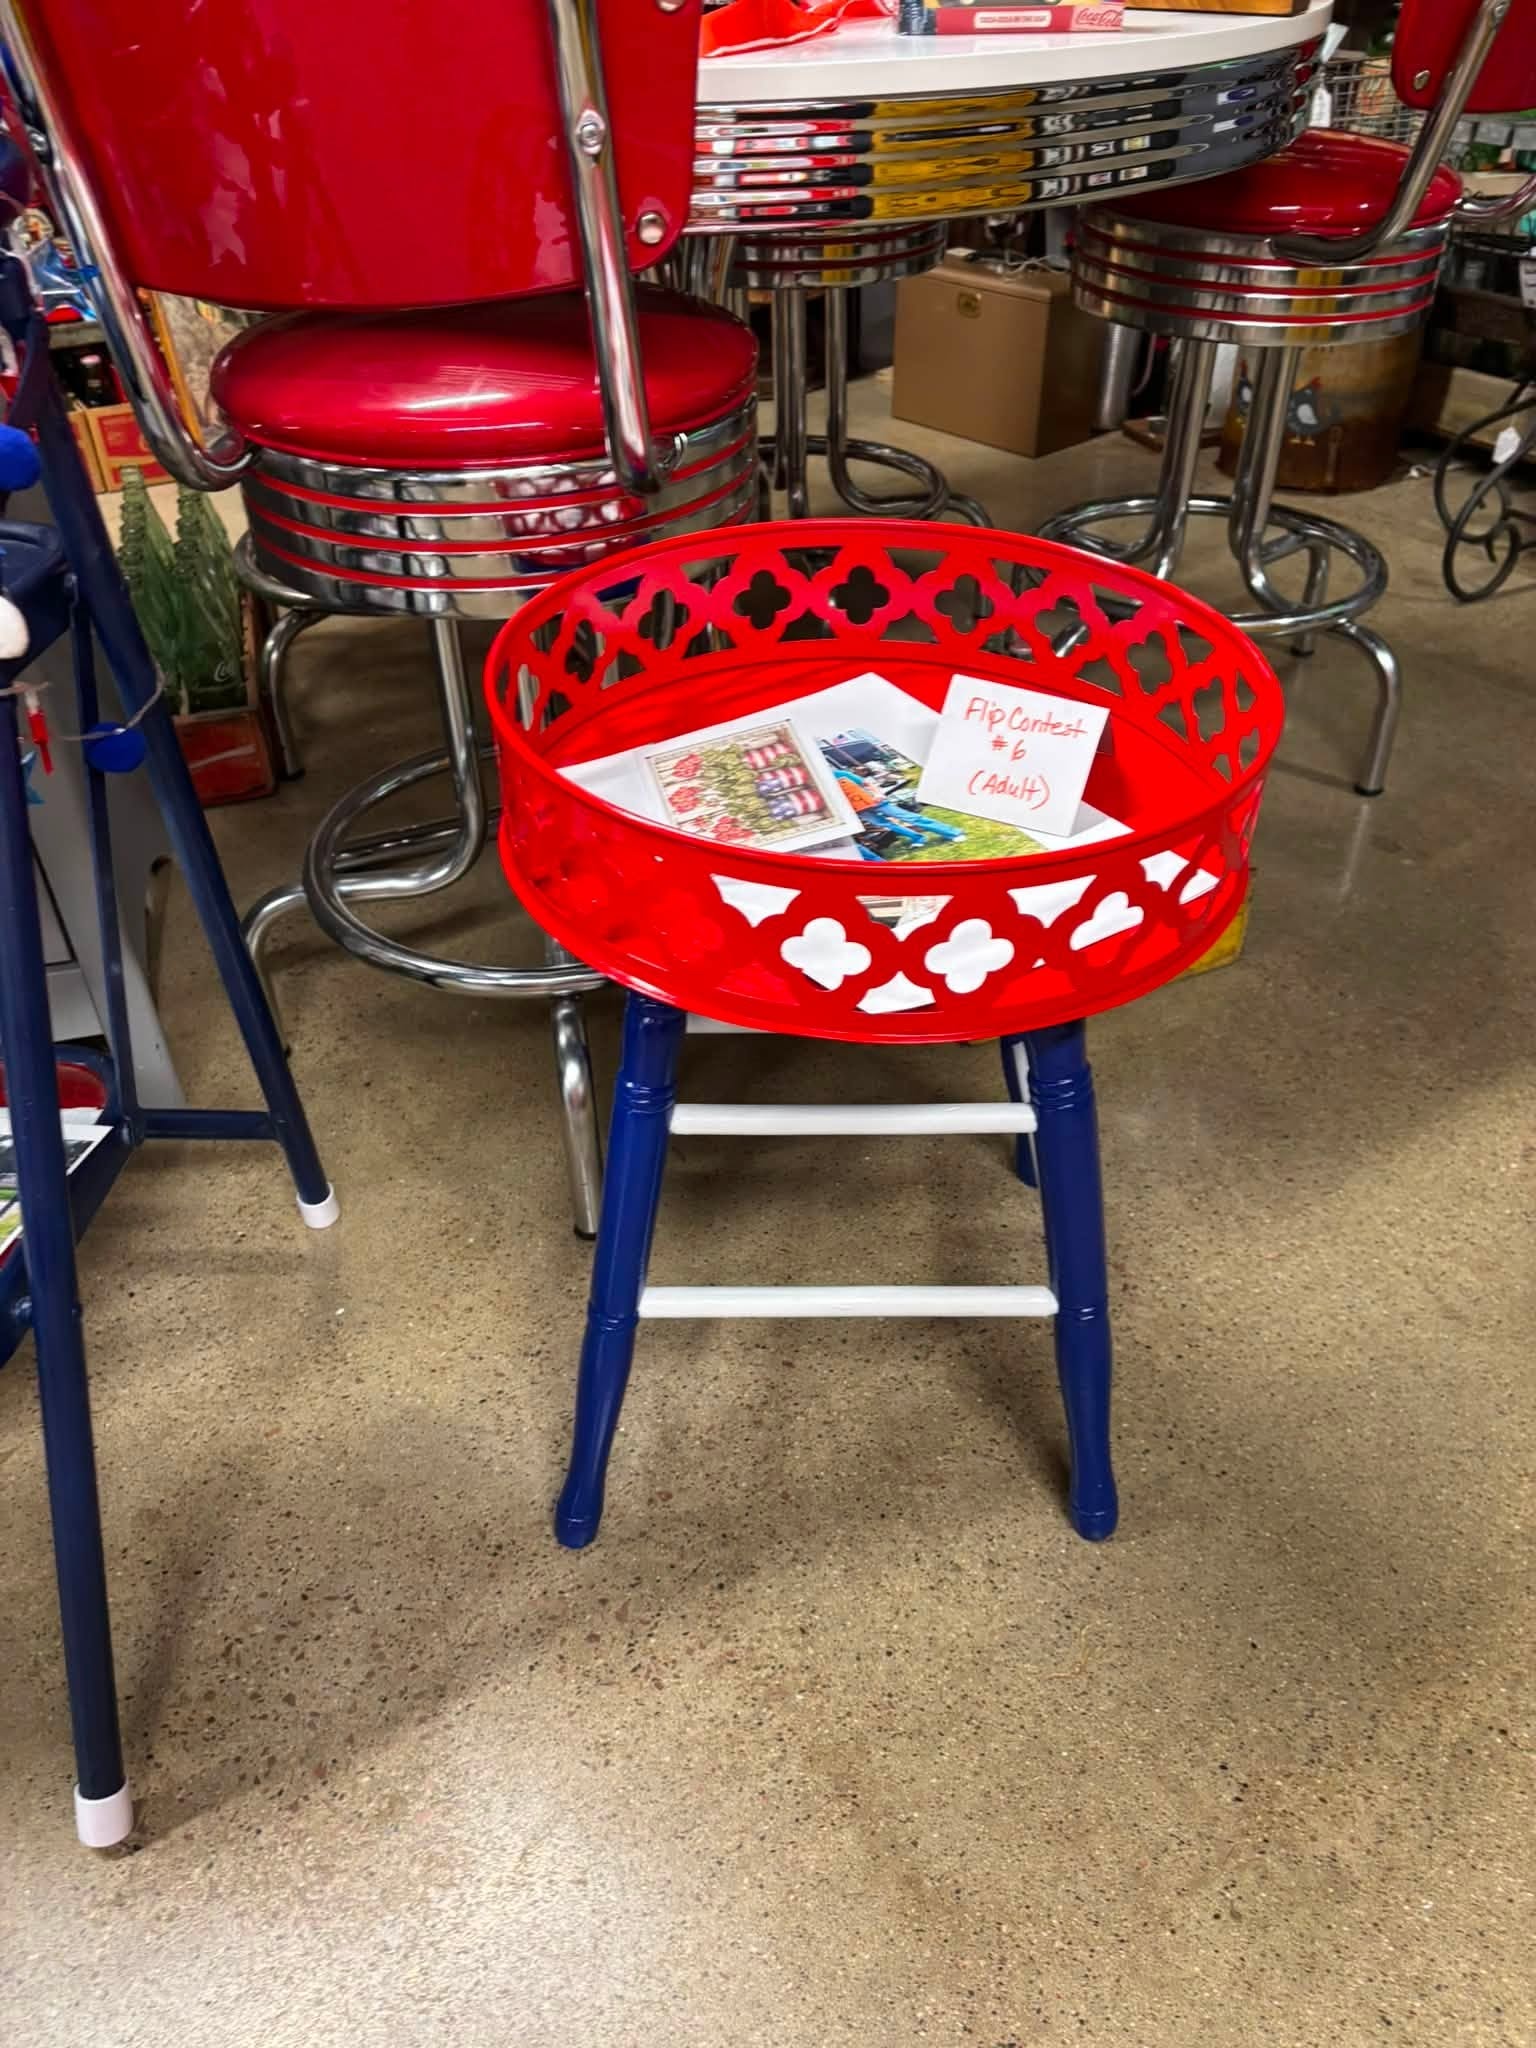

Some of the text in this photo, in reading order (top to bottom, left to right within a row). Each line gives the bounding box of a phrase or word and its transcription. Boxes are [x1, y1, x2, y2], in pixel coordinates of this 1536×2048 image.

[965, 697, 1087, 736] Flip Contest
[968, 771, 1051, 809] (Adult)
